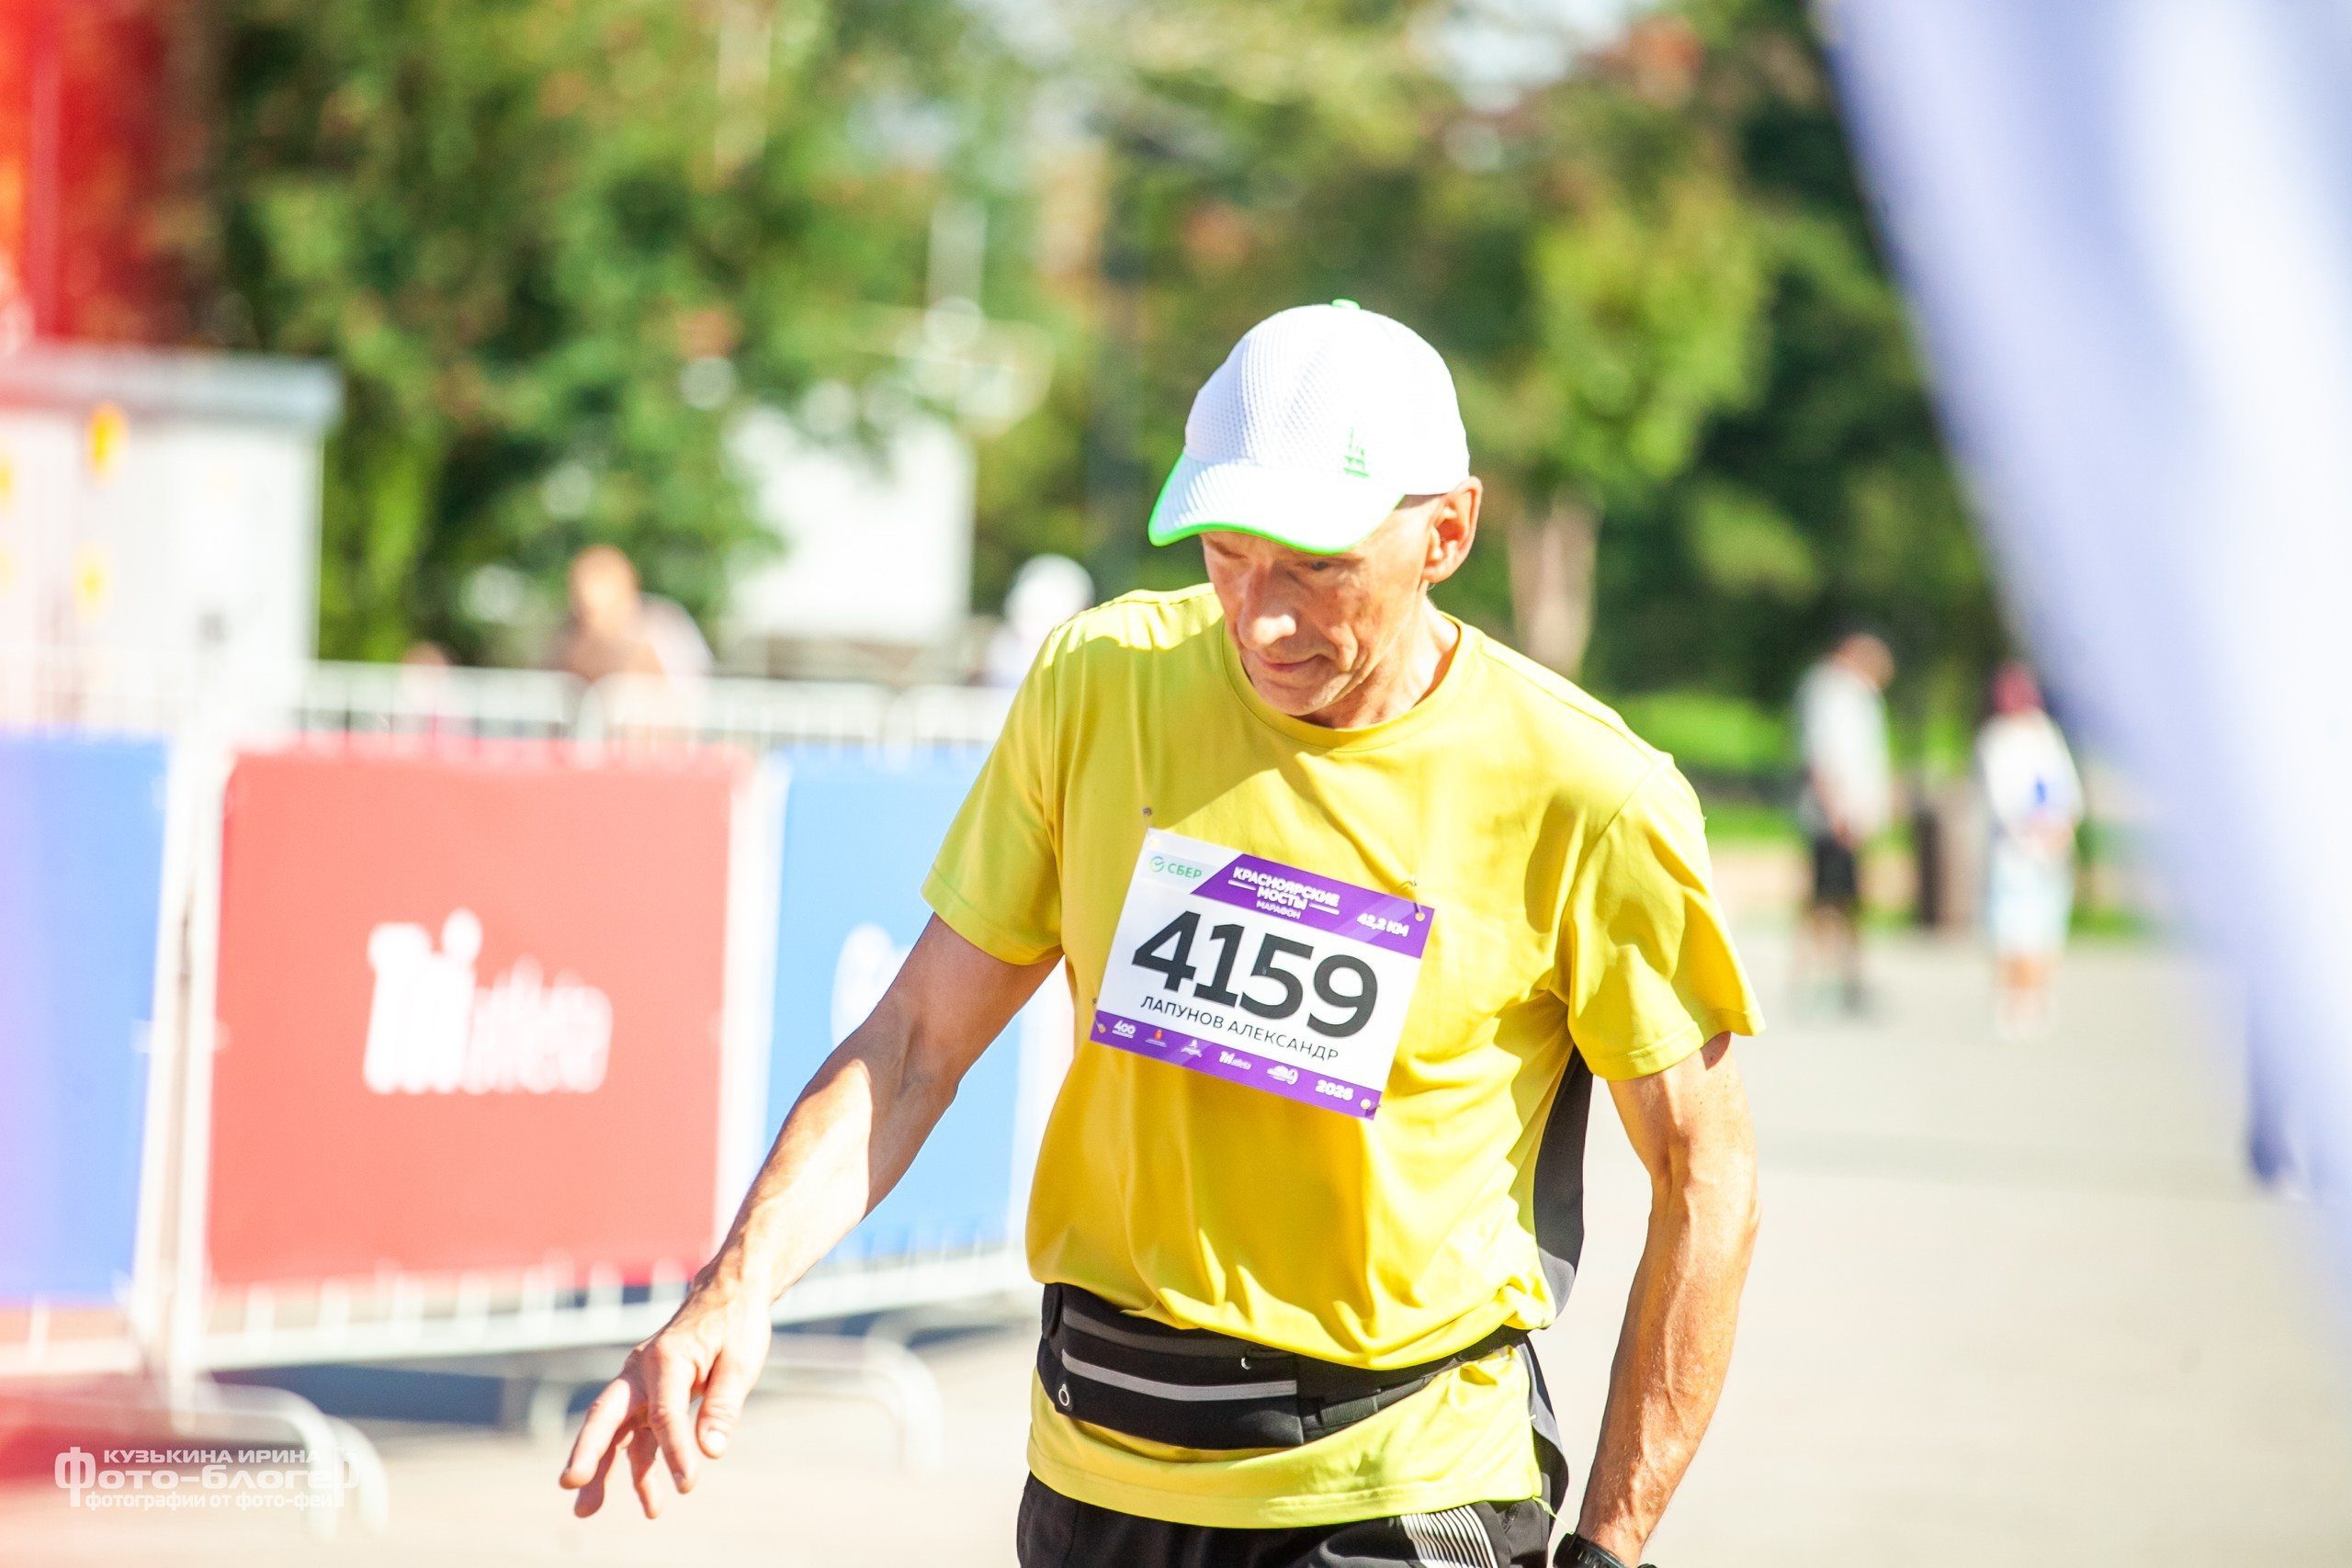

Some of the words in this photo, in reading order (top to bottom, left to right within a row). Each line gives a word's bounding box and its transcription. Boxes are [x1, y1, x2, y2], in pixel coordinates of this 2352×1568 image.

[1168, 863, 1203, 879] СБЕР
[1233, 866, 1340, 908] КРАСНОЯРСКИЕ
[1257, 887, 1308, 910] МОСТЫ
[1256, 900, 1302, 919] МАРАФОН
[1386, 920, 1409, 937] КМ
[1131, 910, 1378, 1038] 4159
[1140, 996, 1224, 1029] ЛАПУНОВ
[1227, 1021, 1339, 1062] АЛЕКСАНДР
